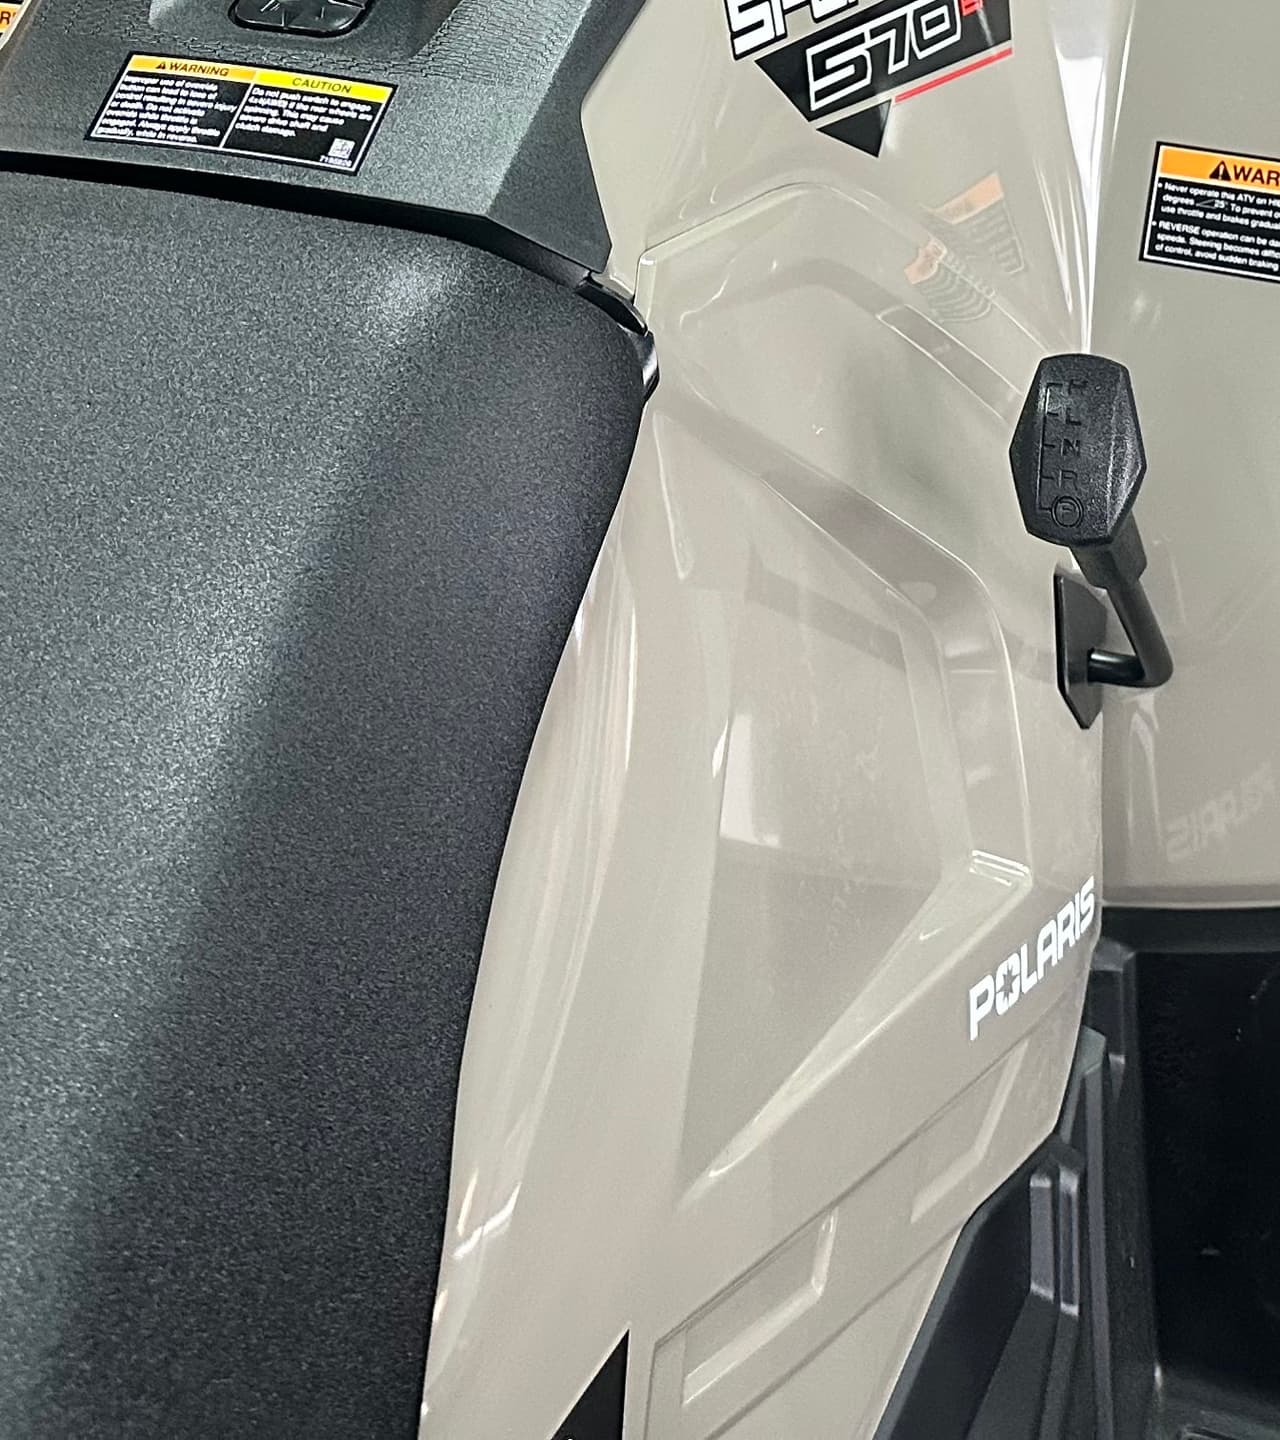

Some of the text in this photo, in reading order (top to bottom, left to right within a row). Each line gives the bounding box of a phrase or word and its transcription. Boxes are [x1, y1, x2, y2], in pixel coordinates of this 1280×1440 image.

[167, 60, 231, 77] WARNING
[289, 76, 353, 94] CAUTION
[1060, 437, 1081, 457] N
[969, 875, 1095, 1041] POLARIS
